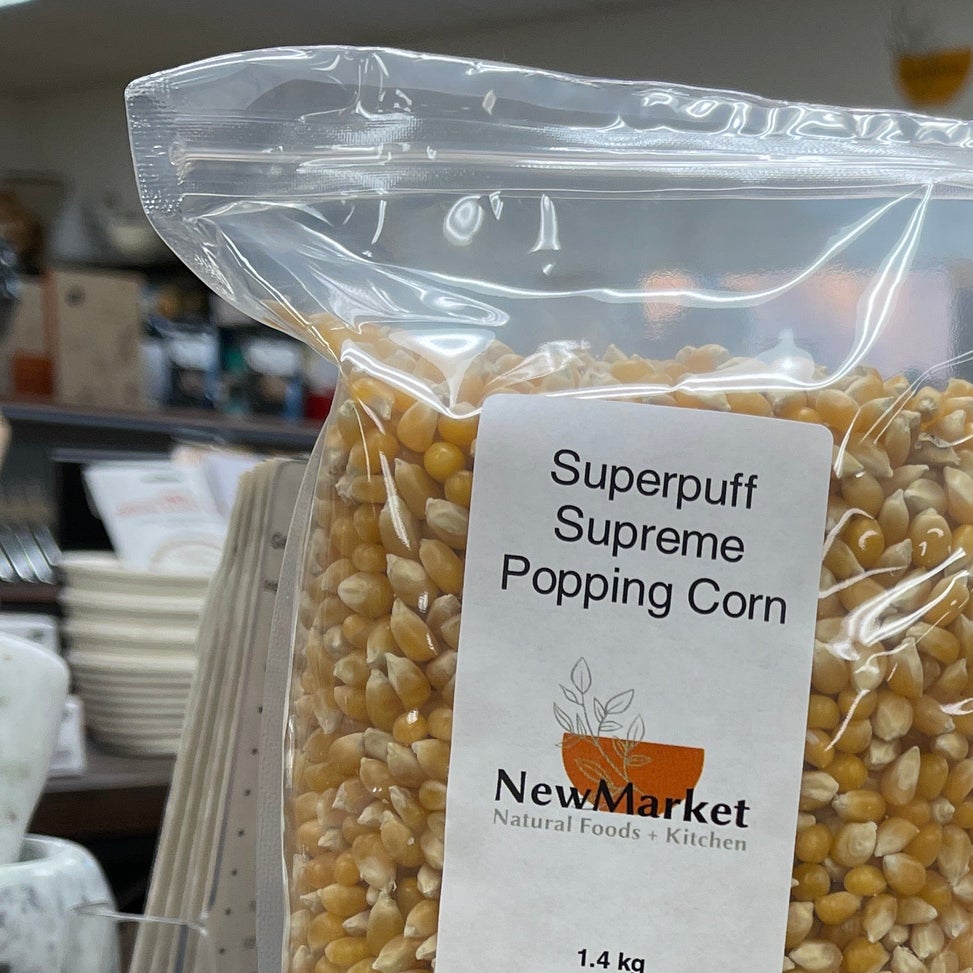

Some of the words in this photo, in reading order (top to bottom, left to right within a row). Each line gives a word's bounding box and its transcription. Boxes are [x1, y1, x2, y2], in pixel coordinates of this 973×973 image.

[549, 448, 758, 510] Superpuff
[553, 504, 746, 564] Supreme
[500, 553, 673, 619] Popping
[687, 577, 788, 625] Corn
[494, 767, 752, 829] NewMarket
[492, 807, 573, 833] Natural
[579, 817, 641, 841] Foods
[665, 826, 748, 852] Kitchen
[576, 948, 611, 970] 1.4
